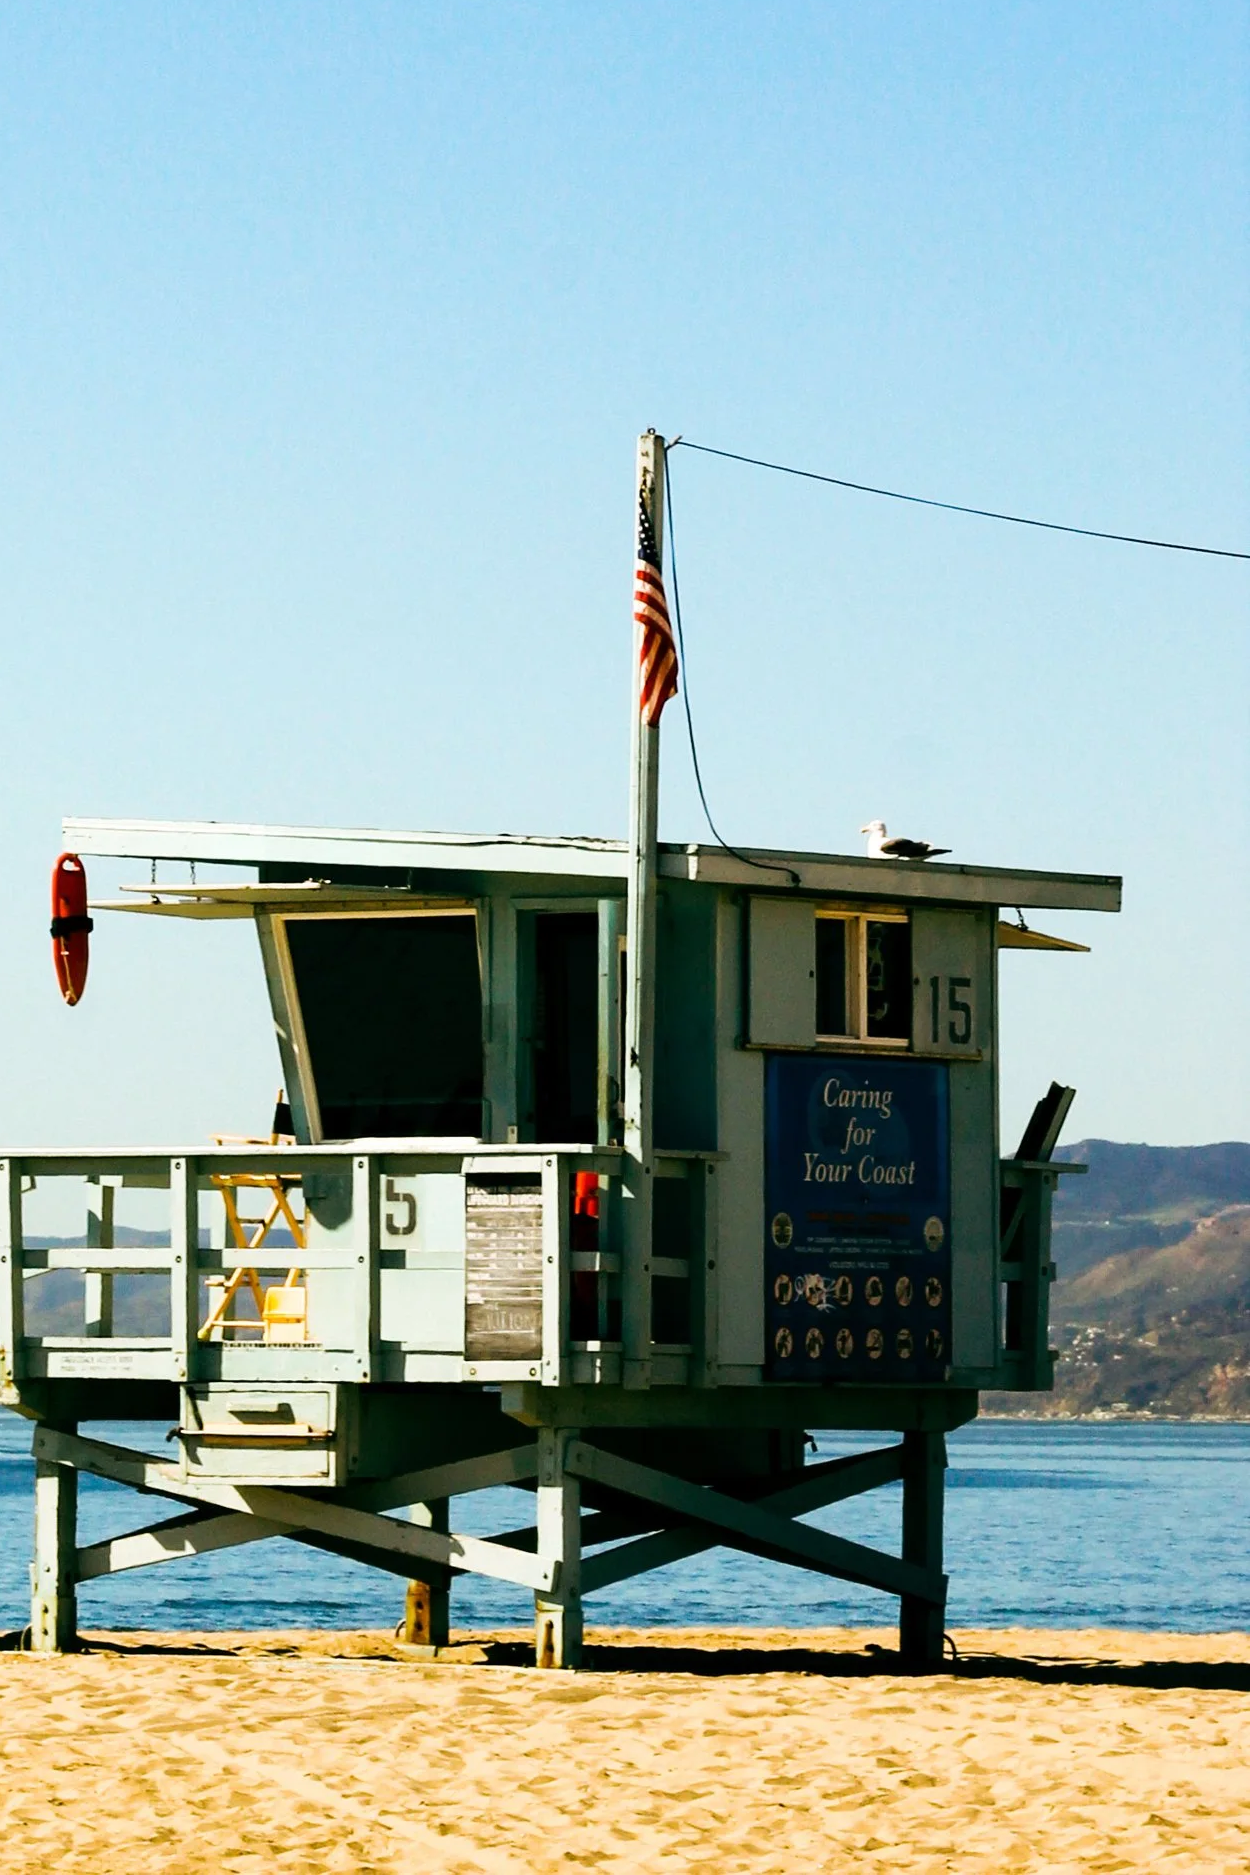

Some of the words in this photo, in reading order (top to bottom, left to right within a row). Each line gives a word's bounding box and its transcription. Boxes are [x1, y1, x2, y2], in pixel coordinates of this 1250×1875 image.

[930, 976, 971, 1044] 15
[823, 1077, 894, 1119] Caring
[840, 1116, 876, 1155] for
[803, 1152, 853, 1183] Your
[857, 1154, 917, 1185] Coast
